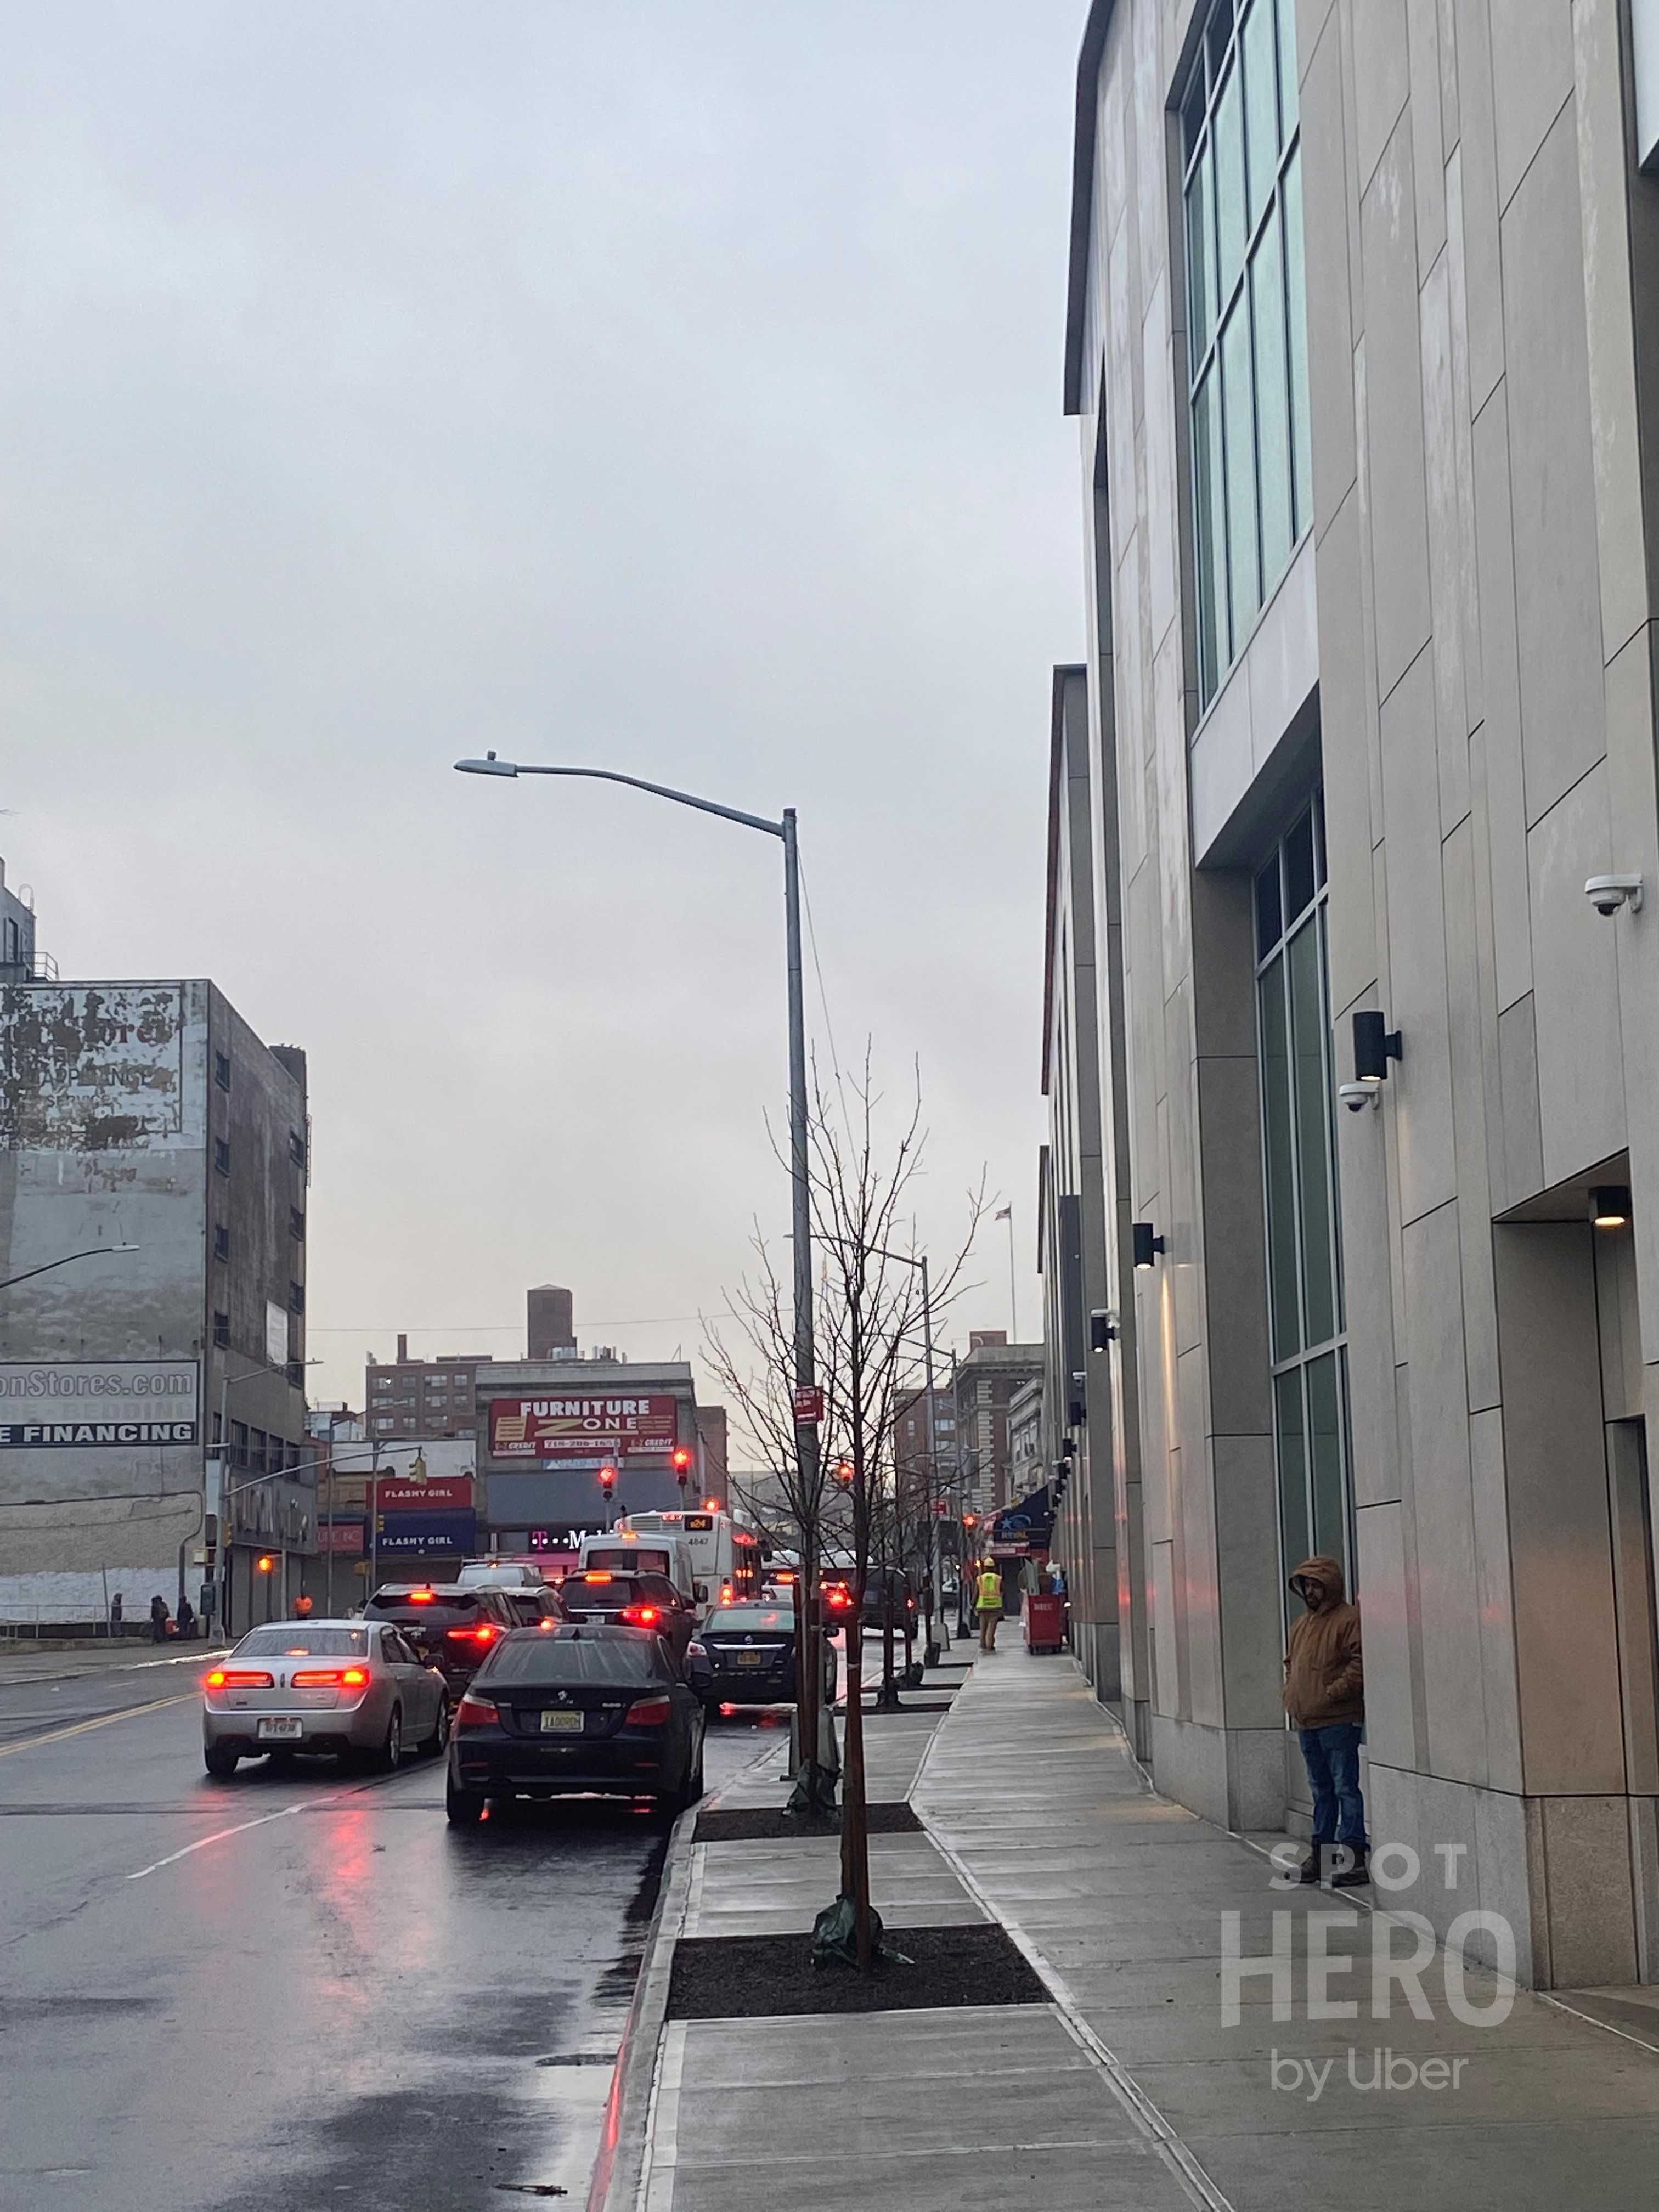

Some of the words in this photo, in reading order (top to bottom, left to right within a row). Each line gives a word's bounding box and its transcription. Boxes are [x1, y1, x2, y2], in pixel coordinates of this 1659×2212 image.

[521, 1400, 650, 1417] FURNITURE
[24, 1424, 192, 1442] FINANCING
[534, 1418, 639, 1437] ZONE
[385, 1489, 426, 1498] FLASHY
[382, 1537, 425, 1546] FLASHY
